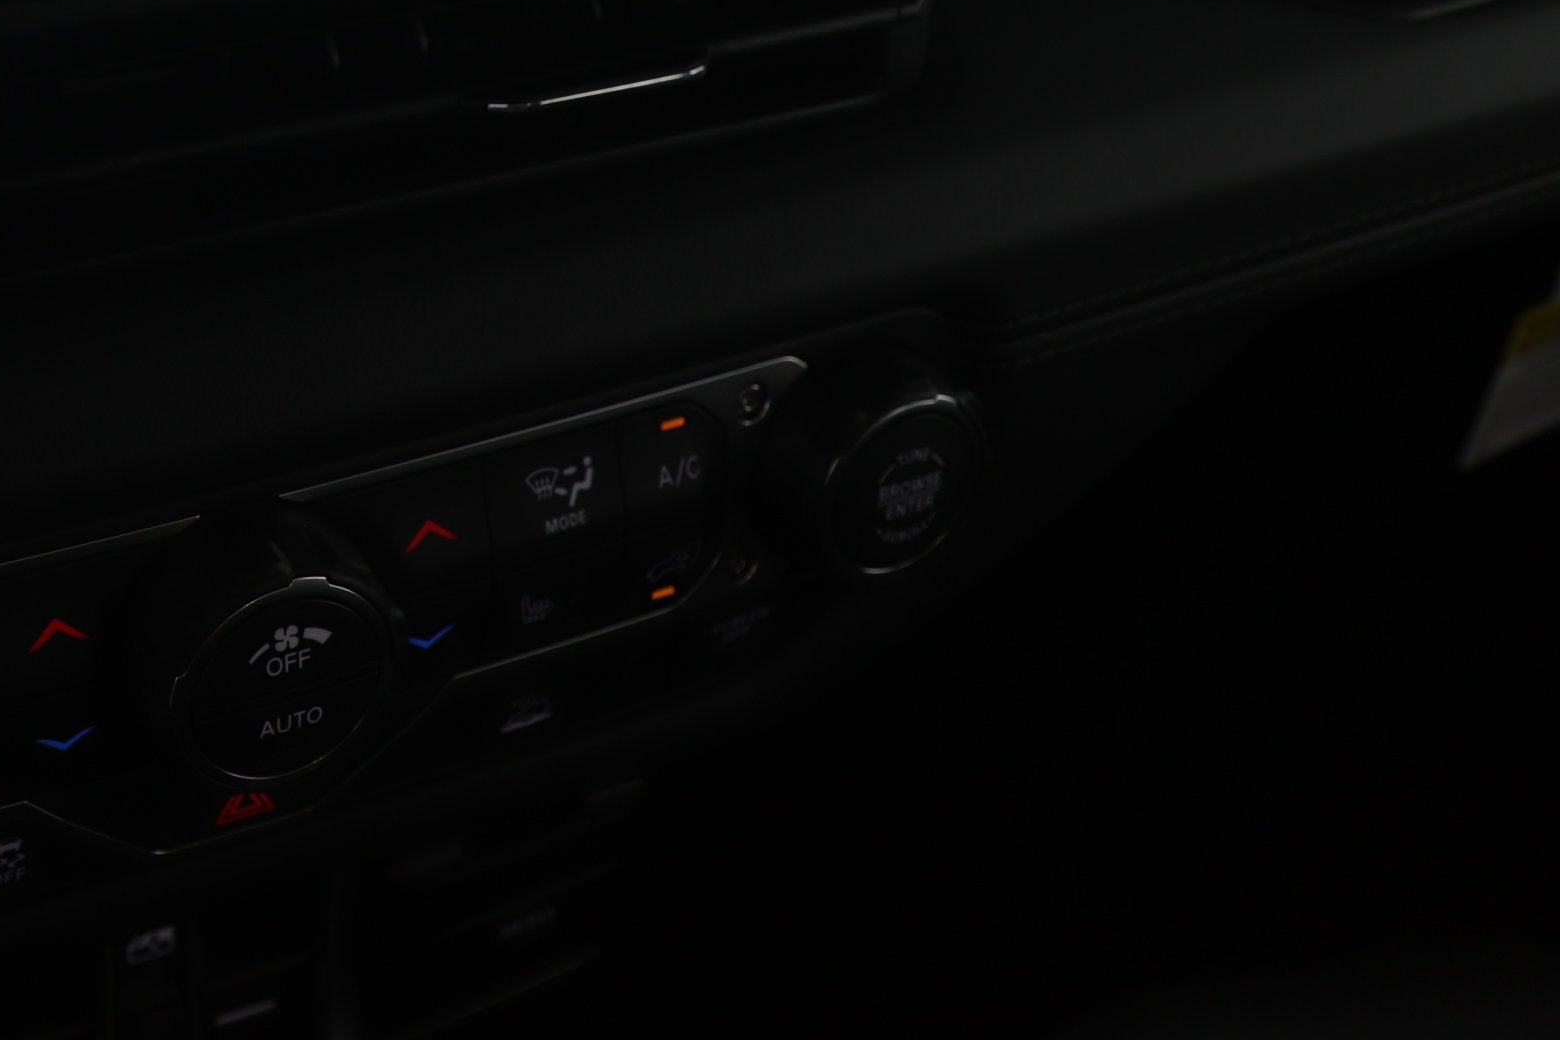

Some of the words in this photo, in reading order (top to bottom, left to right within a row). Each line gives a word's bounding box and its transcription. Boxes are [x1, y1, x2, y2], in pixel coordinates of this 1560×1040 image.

[658, 454, 701, 490] A/C
[545, 509, 588, 535] MODE
[885, 494, 935, 521] ENTER
[266, 648, 311, 677] OFF
[259, 705, 323, 739] AUTO
